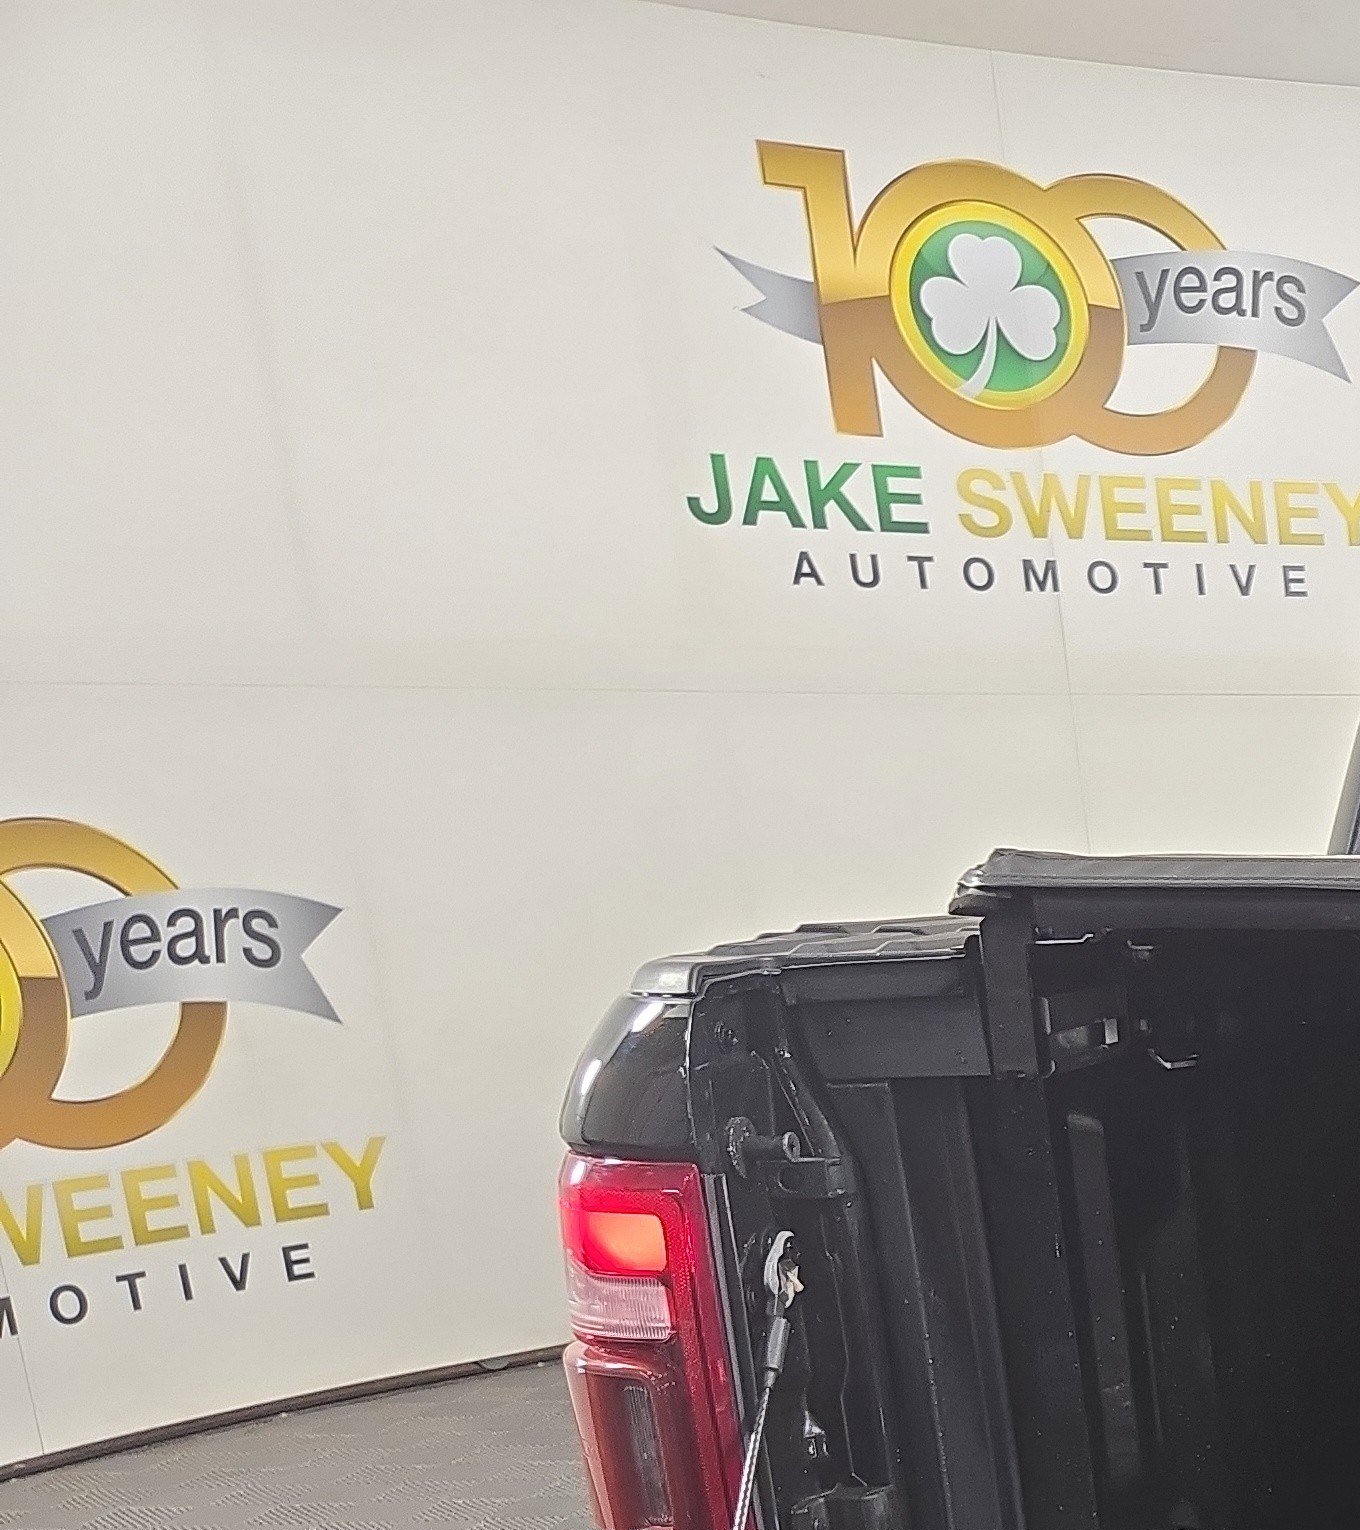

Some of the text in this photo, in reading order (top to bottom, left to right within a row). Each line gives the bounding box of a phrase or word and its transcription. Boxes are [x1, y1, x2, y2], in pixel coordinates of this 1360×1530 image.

[756, 140, 1307, 456] 100 years
[687, 452, 930, 536] JAKE
[792, 551, 1309, 598] AUTOMOTIVE
[72, 905, 282, 1000] years
